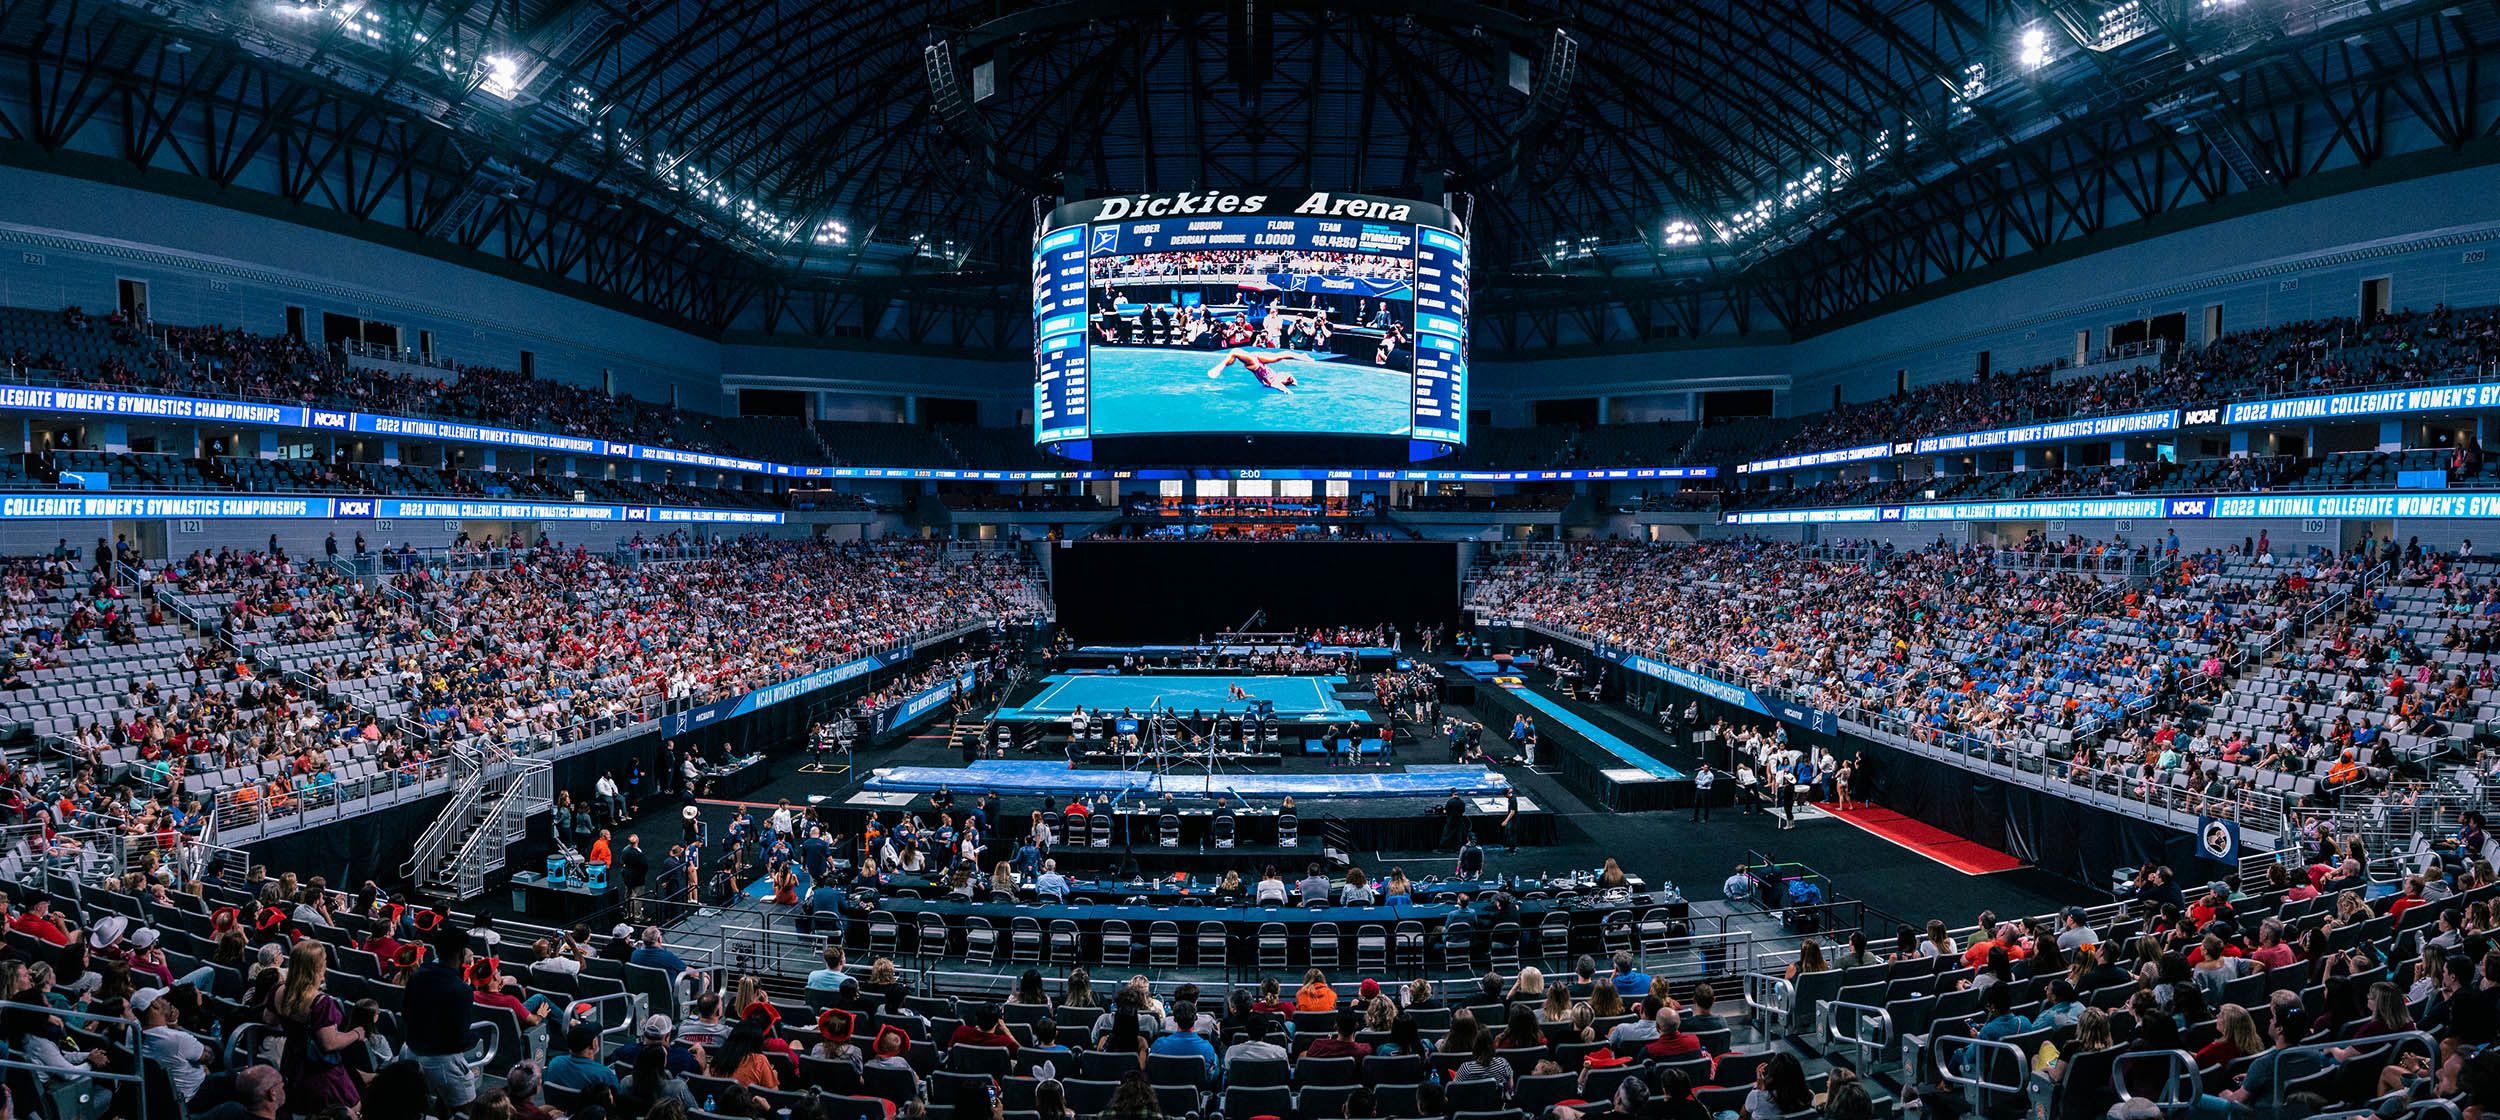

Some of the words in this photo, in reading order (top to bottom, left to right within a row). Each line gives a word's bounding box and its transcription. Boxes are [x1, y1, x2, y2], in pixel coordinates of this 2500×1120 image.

[1093, 190, 1268, 221] Dickies
[1294, 192, 1411, 222] Arena
[1267, 221, 1295, 230] FLOOR
[1318, 222, 1342, 232] TEAM
[1254, 233, 1296, 246] 0.0000
[24, 253, 43, 265] 221
[2465, 251, 2484, 263] 209
[212, 281, 229, 292] 222
[2281, 279, 2297, 291] 208
[56, 392, 115, 412] WOMEN'S
[118, 395, 192, 417] GYMNASTICS
[194, 402, 281, 423] CHAMPIONSHIPS
[2234, 403, 2268, 422] 2022
[2270, 399, 2327, 419] NATIONAL
[2330, 391, 2406, 415] COLLEGIATE
[2408, 387, 2477, 409] WOMEN'S
[314, 411, 347, 428] NCAA
[2184, 408, 2219, 425] NCAA
[375, 418, 400, 433] 2022
[401, 420, 437, 436] NATIONAL
[438, 424, 478, 441] COLLEGIATE
[479, 429, 510, 444] WOMEN'S
[510, 432, 549, 448] GYMNASTICS
[549, 436, 593, 452] CHAMPIONSHIPS
[1938, 435, 1967, 450] NATIONAL
[1968, 431, 2006, 447] COLLEGIATE
[2007, 427, 2041, 443] WOMEN'S
[2042, 421, 2093, 439] GYMNASTICS
[2095, 413, 2170, 434] CHAMPIONSHIPS
[1240, 469, 1261, 479] 2:00
[3, 498, 82, 516] COLLEGIATE
[84, 498, 144, 516] WOMEN'S
[146, 499, 220, 516] GYMNASTICS
[222, 499, 307, 516] CHAMPIONSHIPS
[339, 501, 371, 516] NCAA
[400, 502, 423, 516] 2022
[425, 503, 460, 517] NATIONAL
[461, 503, 500, 518] COLLEGIATE
[501, 504, 531, 518] WOMEN'S
[531, 505, 569, 519] GYMNASTICS
[569, 506, 612, 519] CHAMPIONSHIPS
[1995, 504, 2029, 519] WOMEN'S
[2030, 502, 2081, 517] GYMNASTICS
[2082, 501, 2157, 517] CHAMPIONSHIPS
[2172, 500, 2206, 516] NCAA
[2221, 499, 2256, 516] 2022
[2258, 498, 2314, 516] NATIONAL
[2317, 497, 2395, 516] COLLEGIATE
[2397, 496, 2466, 516] WOMEN'S
[183, 521, 200, 532] 121
[377, 520, 392, 531] 122
[445, 521, 459, 531] 123
[2052, 521, 2064, 530] 107
[2117, 520, 2130, 531] 108
[2305, 520, 2323, 532] 109
[755, 690, 773, 709] NCAA
[773, 680, 801, 702] WOMEN'S
[801, 671, 833, 694] GYMNASTICS
[833, 660, 869, 682] CHAMPIONSHIPS
[1668, 667, 1699, 691] GYMNASTICS
[1699, 676, 1746, 706] CHAMPIONSHIPS
